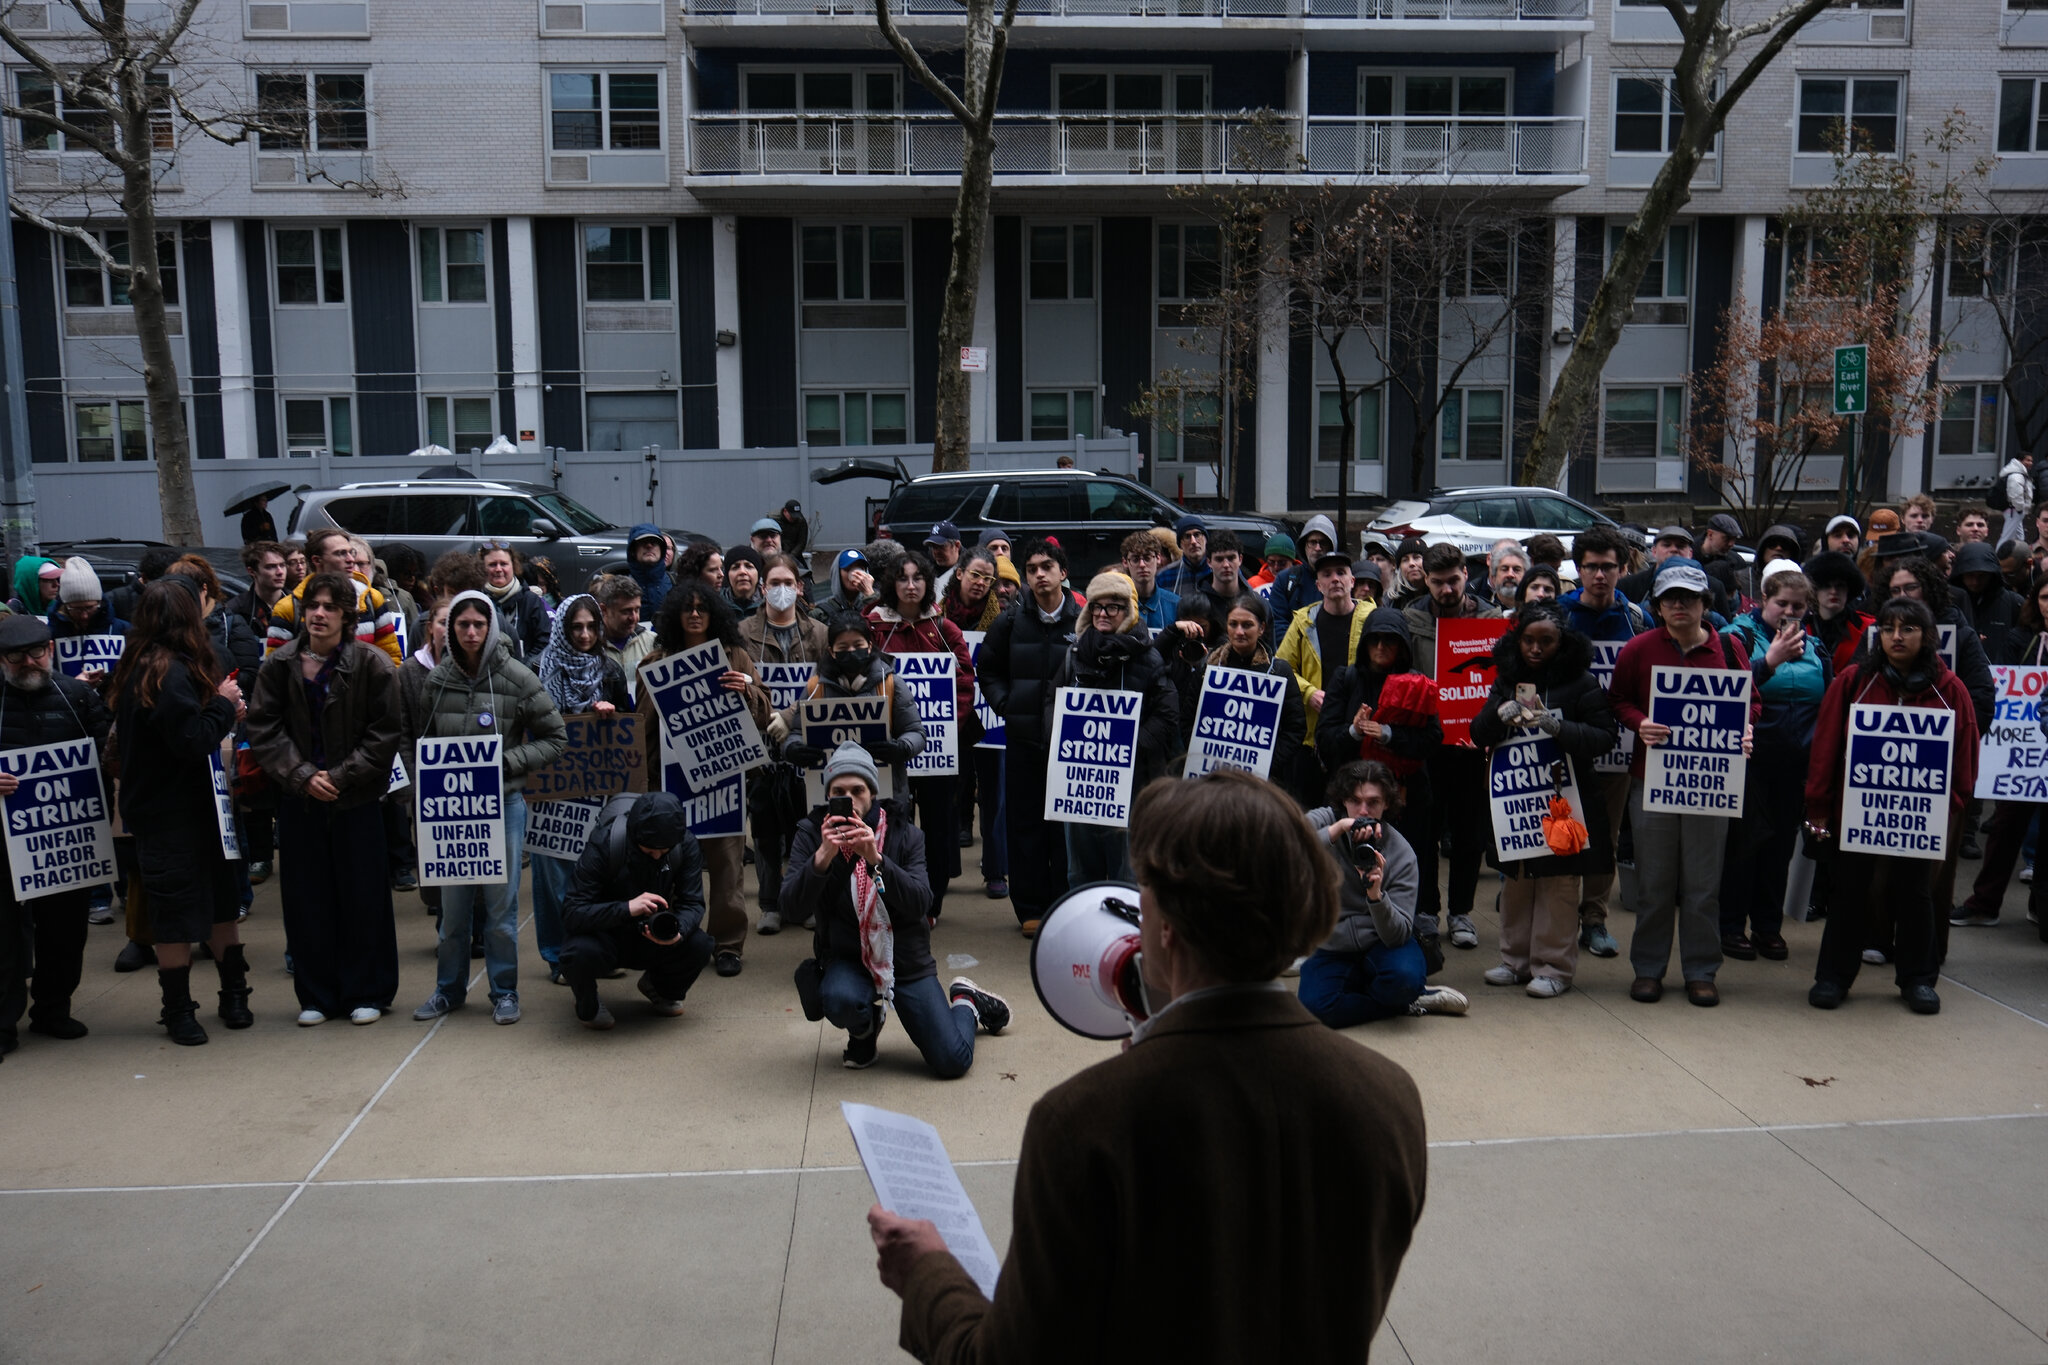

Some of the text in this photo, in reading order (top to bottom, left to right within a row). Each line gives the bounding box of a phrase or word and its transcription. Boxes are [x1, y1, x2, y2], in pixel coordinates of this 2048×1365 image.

[1840, 383, 1860, 391] River
[1841, 371, 1859, 381] East
[1459, 544, 1483, 552] HAPPY
[60, 639, 122, 658] UAW
[1449, 638, 1487, 648] Professional
[645, 645, 720, 688] UAW
[1470, 671, 1482, 683] In
[680, 678, 712, 704] ON
[1208, 670, 1282, 699] UAW
[1656, 672, 1747, 697] UAW
[771, 688, 795, 707] ON
[1065, 692, 1138, 715] UAW
[668, 691, 741, 731] STRIKE
[806, 702, 884, 722] UAW
[1224, 699, 1254, 720] ON
[1681, 703, 1716, 725] ON
[566, 718, 635, 748] ENTS
[685, 717, 743, 749] UNFAIR
[1083, 720, 1111, 740] ON
[1199, 716, 1272, 745] STRIKE
[1855, 710, 1949, 736] UAW
[831, 727, 861, 744] ON
[1985, 726, 2035, 745] MORE
[420, 741, 498, 765] UAW
[695, 733, 746, 763] LABOR
[1060, 739, 1130, 763] STRIKE
[1203, 742, 1258, 765] UNFAIR
[1508, 743, 1539, 766] ON
[1881, 741, 1918, 763] ON
[0, 744, 92, 777] UAW
[689, 744, 764, 783] PRACTICE
[906, 755, 955, 769] ACTICE
[1663, 753, 1730, 773] UNFAIR
[443, 771, 474, 794] ON
[1066, 766, 1119, 784] UNFAIR
[1665, 772, 1725, 790] LABOR
[1852, 763, 1944, 790] STRIKE
[35, 777, 71, 802] ON
[1067, 783, 1115, 801] LABOR
[1650, 789, 1738, 809] PRACTICE
[12, 797, 101, 830] STRIKE
[422, 795, 498, 818] STRIKE
[532, 801, 591, 822] UNFAIR
[682, 783, 739, 827] TRIKE
[1054, 798, 1125, 819] PRACTICE
[1861, 792, 1931, 813] UNFAIR
[432, 823, 491, 841] UNFAIR
[531, 816, 584, 838] LABOR
[1863, 811, 1926, 831] LABOR
[26, 826, 96, 852] UNFAIR
[524, 831, 588, 854] RACTIC
[1501, 832, 1545, 851] PRAC
[1848, 828, 1941, 851] PRACTICE
[32, 845, 95, 870] LABOR
[437, 842, 489, 859] LABOR
[20, 859, 113, 892] PRACTICE
[425, 860, 503, 878] PRACTICE
